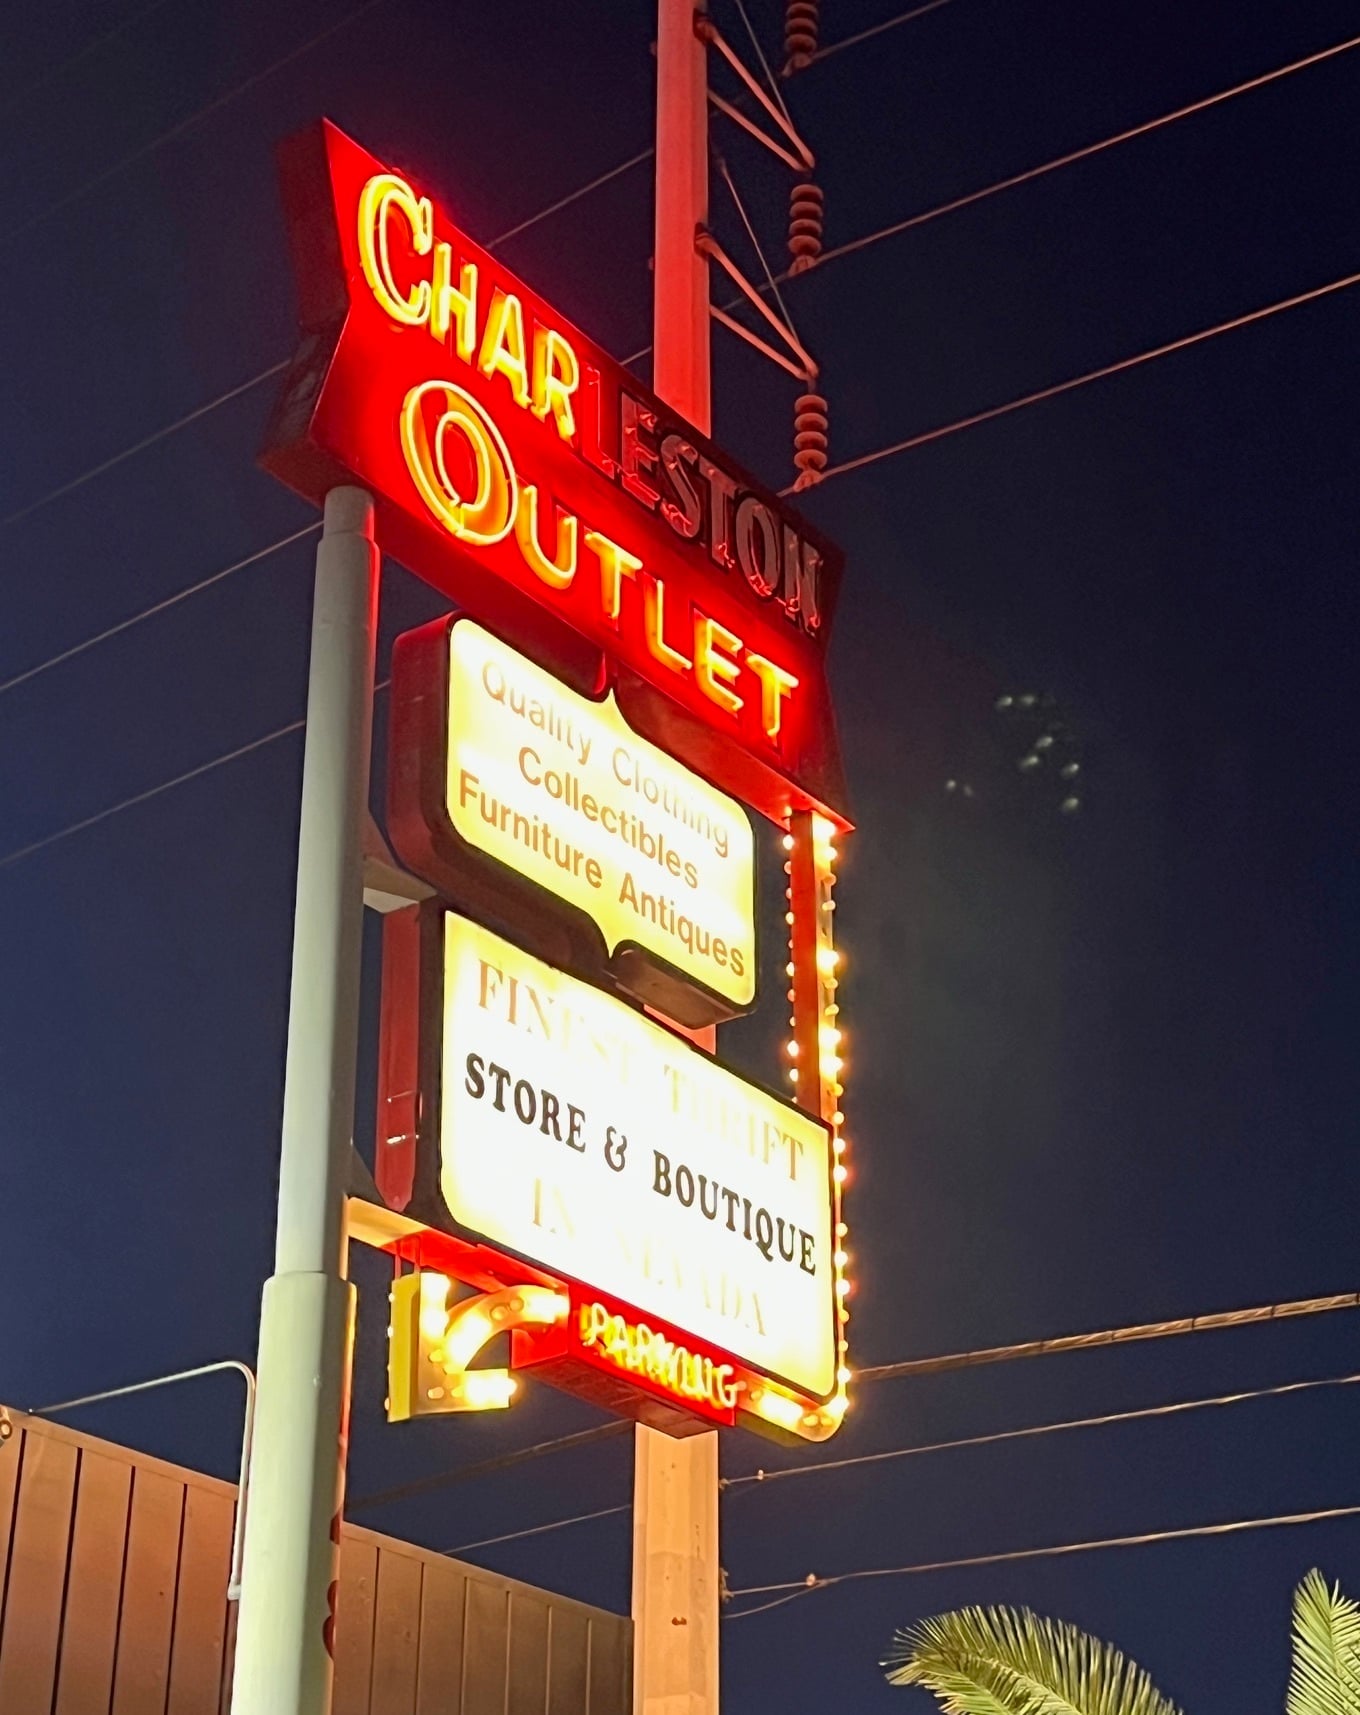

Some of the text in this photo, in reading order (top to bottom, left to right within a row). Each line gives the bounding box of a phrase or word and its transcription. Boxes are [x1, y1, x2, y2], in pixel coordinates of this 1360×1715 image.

[357, 173, 823, 640] CHARLESTON
[400, 380, 799, 746] OUTLET
[482, 660, 729, 859] Quality Clothing
[518, 746, 699, 890] Collectibles
[459, 768, 745, 977] Furniture Antiques
[465, 1052, 816, 1277] STORE & BOUTIQUE
[478, 958, 804, 1182] FIN TIFT
